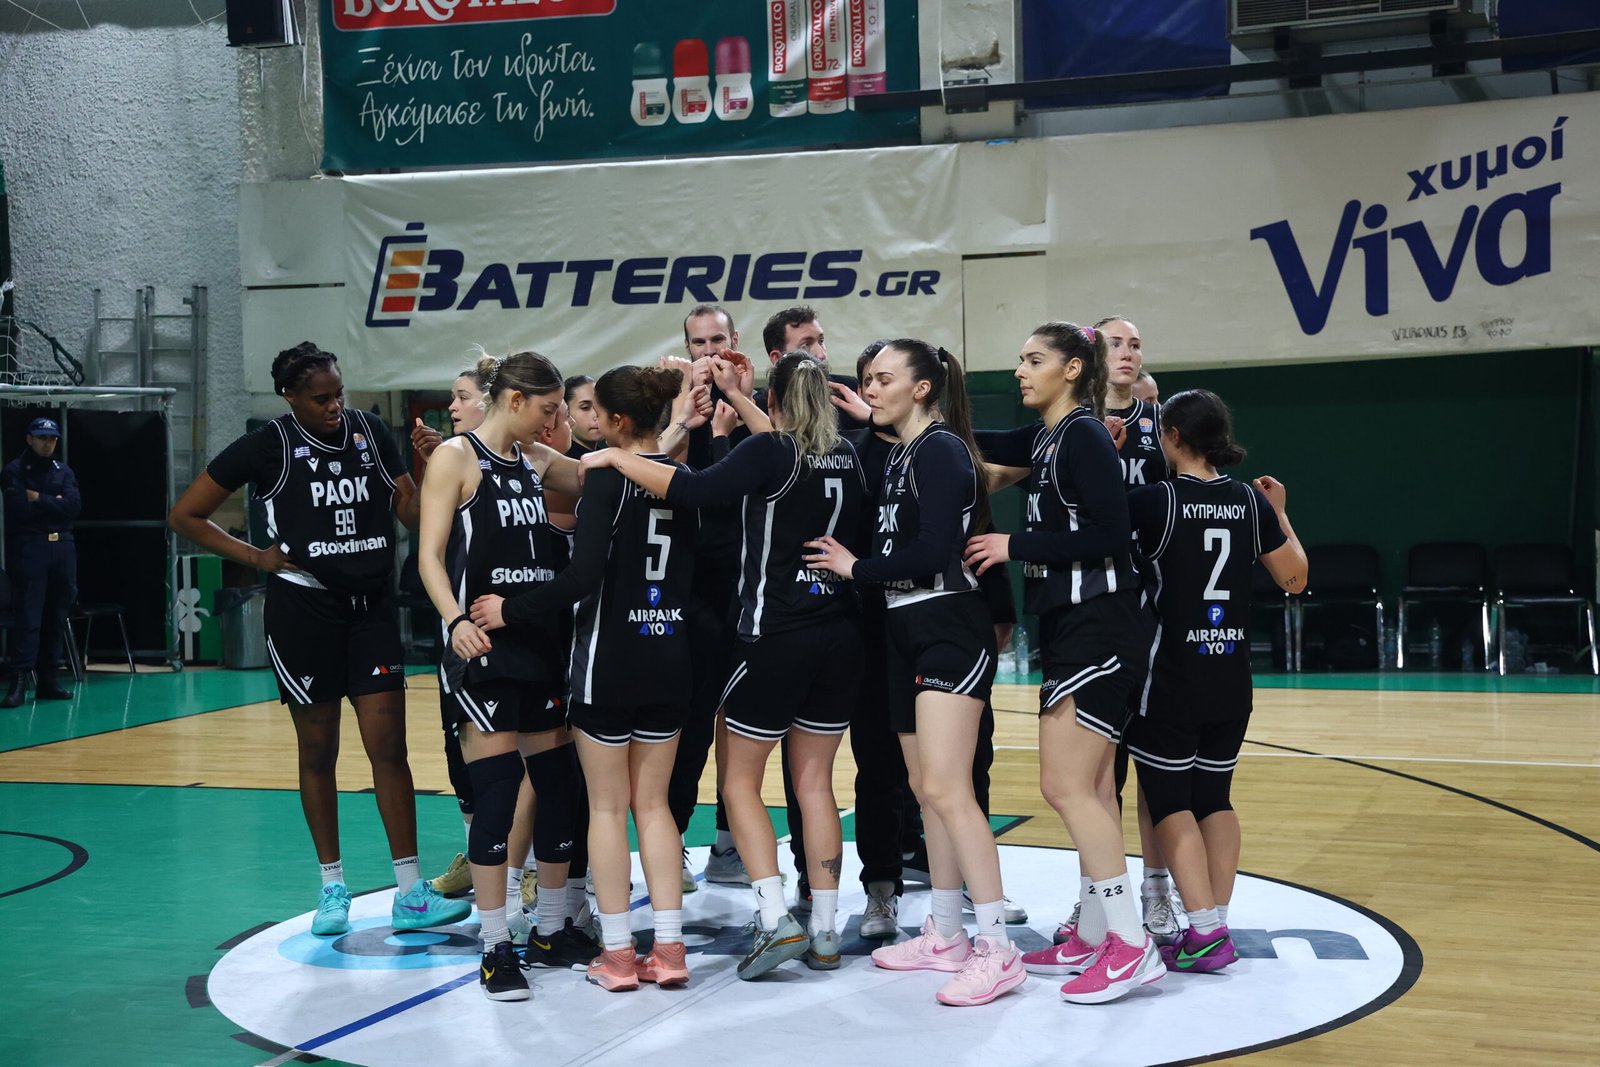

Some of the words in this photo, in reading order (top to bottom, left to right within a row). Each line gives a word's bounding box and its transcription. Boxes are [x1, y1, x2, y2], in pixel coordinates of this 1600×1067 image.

[813, 0, 823, 68] BOROTALCO
[868, 2, 877, 36] SOF
[773, 2, 785, 72] BOROTALCO
[356, 47, 442, 87] Ξέχνα
[451, 50, 492, 80] τον
[504, 33, 596, 97] ιδρώτα.
[494, 92, 528, 122] τη
[534, 80, 594, 142] ζωή.
[1406, 116, 1569, 202] χυμοί
[1250, 182, 1561, 335] Viva
[418, 249, 940, 312] BATTERIES.GR
[310, 476, 370, 507] PAOK
[824, 478, 843, 537] 7
[335, 508, 357, 536] 99
[496, 497, 548, 527] PAOK
[1182, 503, 1246, 520] ΚΥΠΡΙΑΝΟΥ
[308, 535, 388, 558] Stoiximan
[645, 508, 673, 581] 5
[491, 566, 555, 584] Stoixima
[1203, 528, 1231, 600] 2
[628, 608, 683, 622] AIRPARK
[639, 622, 674, 636] 4YOU
[1186, 628, 1245, 642] AIRPARK
[1199, 642, 1234, 655] 4YOU
[1103, 884, 1124, 897] 23
